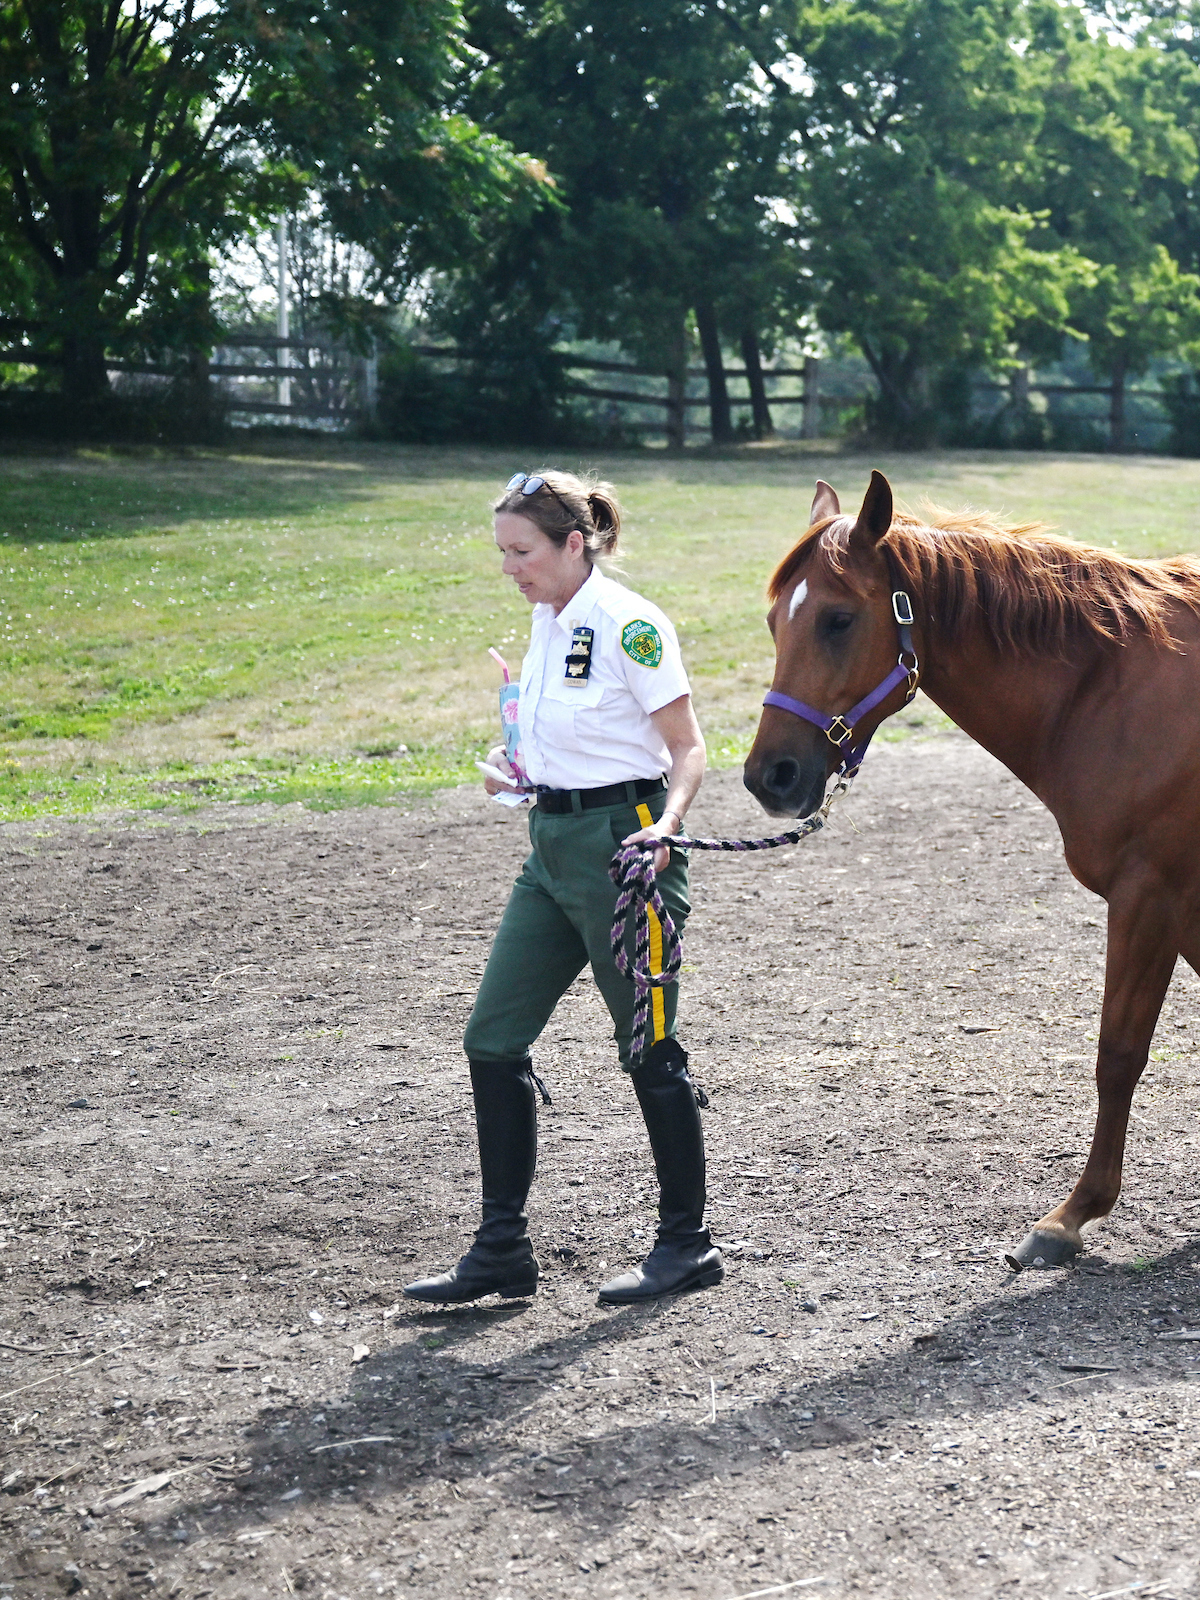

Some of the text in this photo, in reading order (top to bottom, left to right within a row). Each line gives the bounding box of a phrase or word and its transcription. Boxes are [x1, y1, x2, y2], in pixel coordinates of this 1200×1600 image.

[624, 621, 642, 634] PARKS
[623, 625, 651, 645] ENFORCEMENT
[628, 650, 641, 661] CITY
